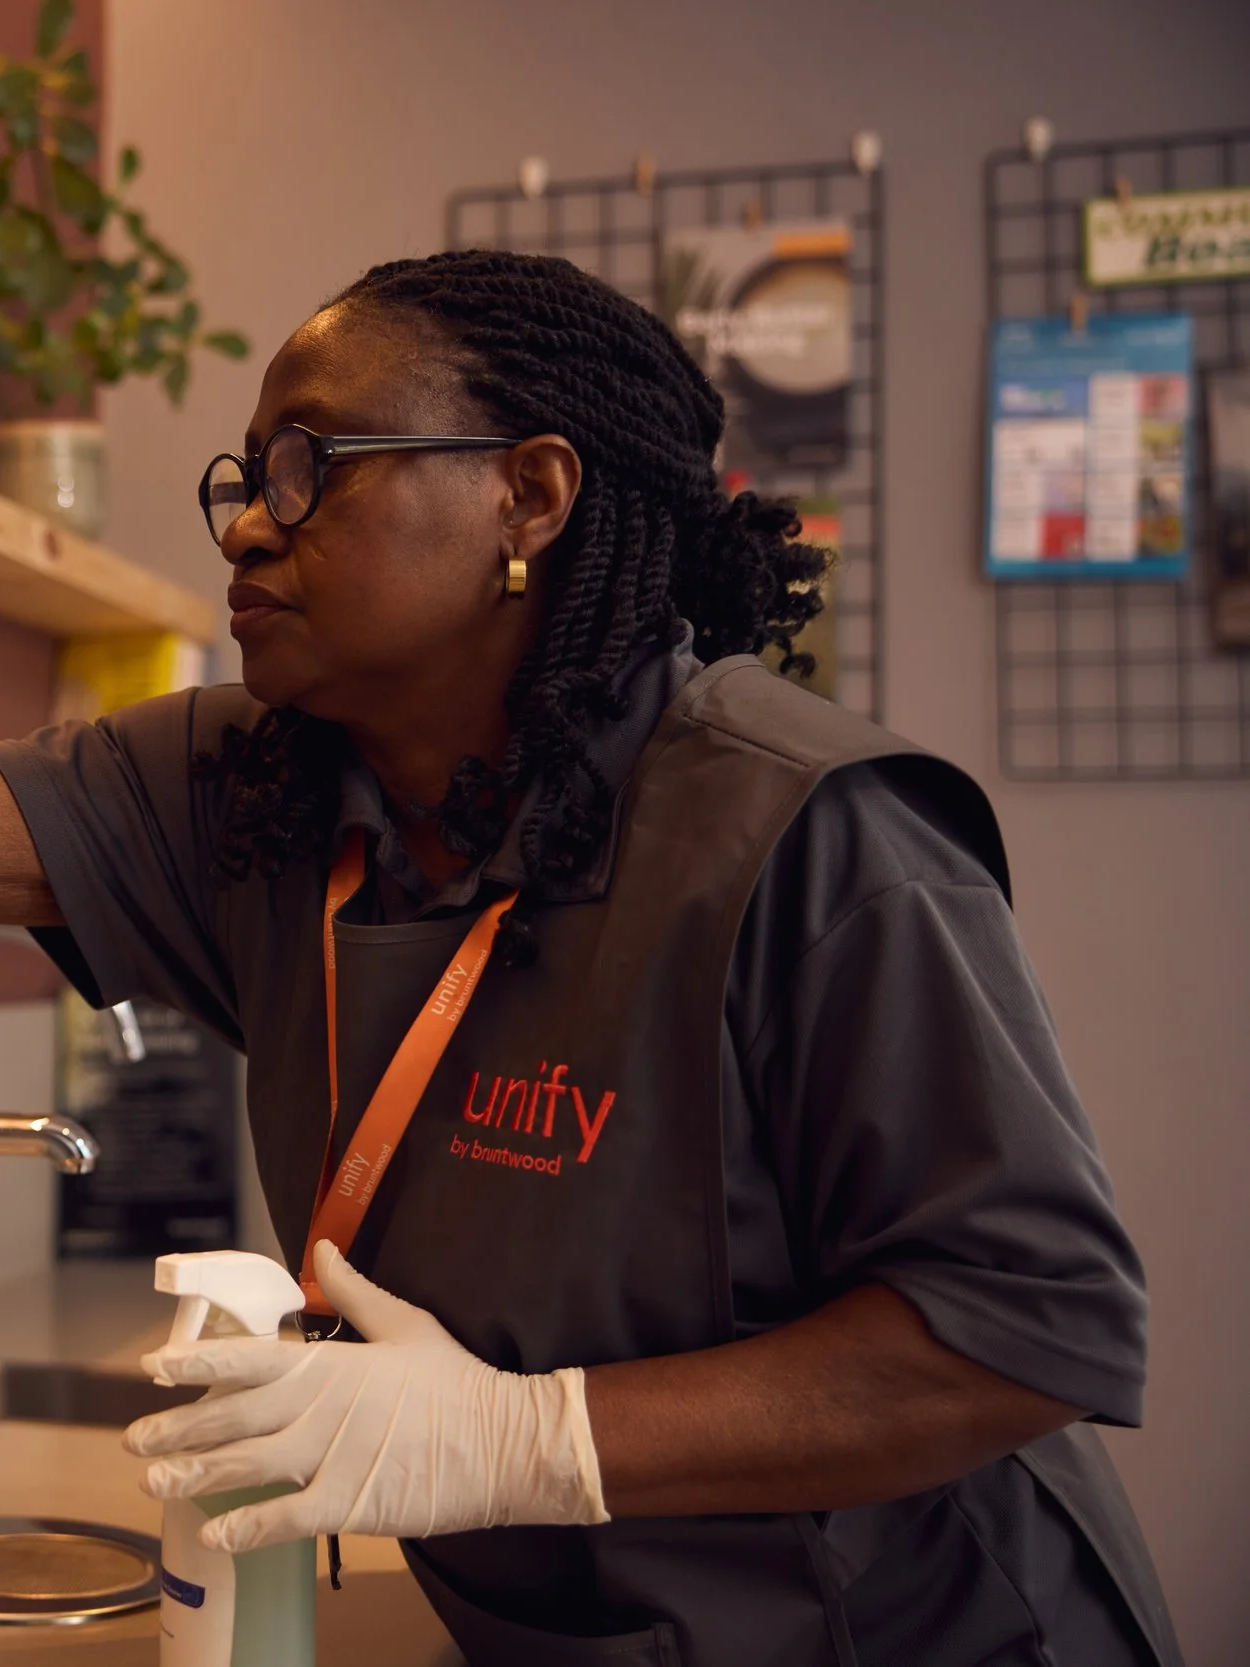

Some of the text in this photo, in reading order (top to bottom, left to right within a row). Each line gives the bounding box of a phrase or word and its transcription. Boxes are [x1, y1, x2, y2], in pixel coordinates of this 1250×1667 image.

[431, 963, 467, 1015] unify
[446, 949, 488, 1022] by bruntwood
[463, 1060, 616, 1163] unify
[338, 1152, 370, 1197] unify
[364, 1144, 392, 1195] bruntwood
[450, 1135, 561, 1176] by bruntwood
